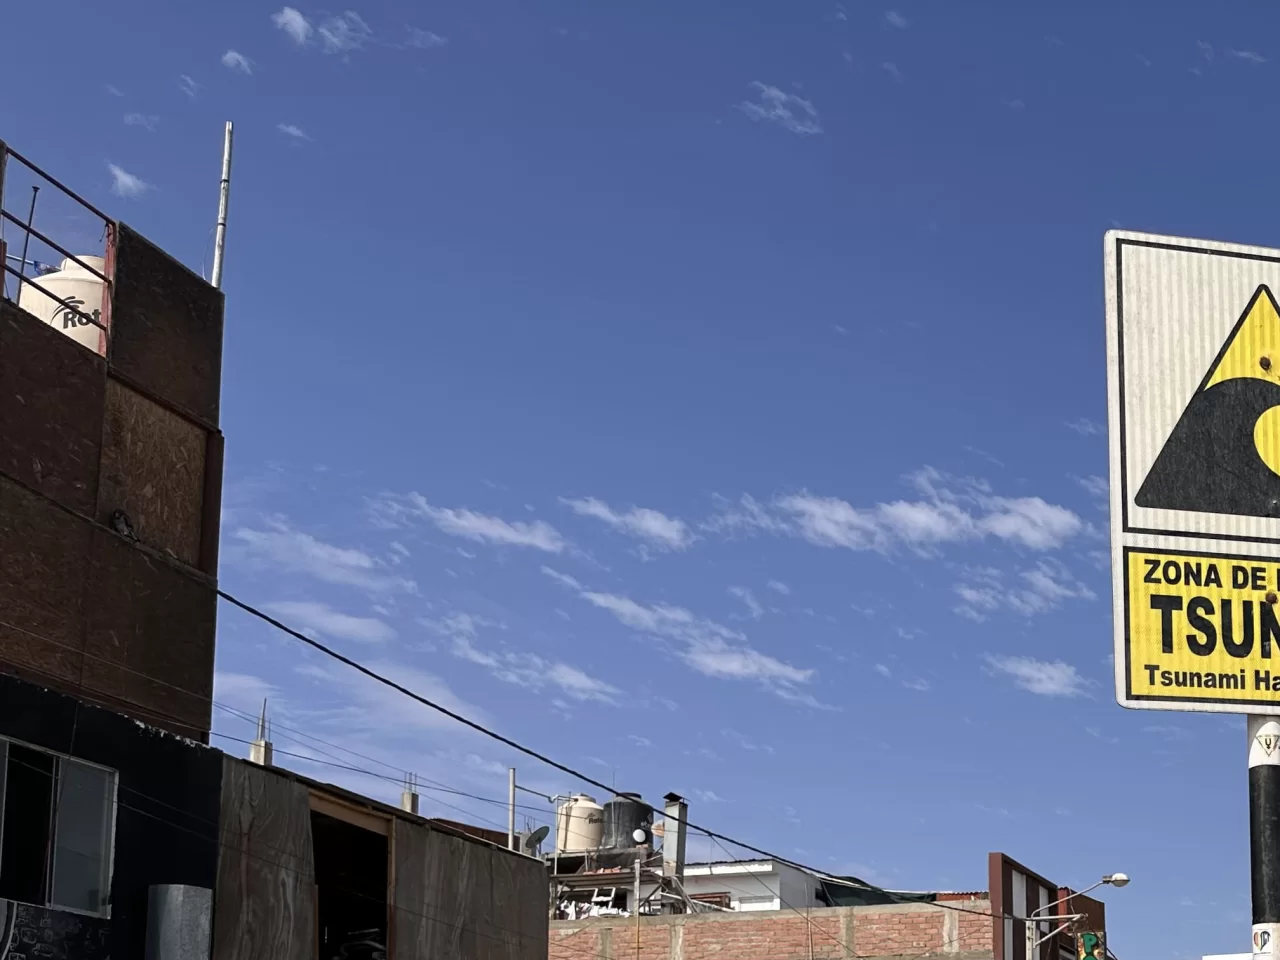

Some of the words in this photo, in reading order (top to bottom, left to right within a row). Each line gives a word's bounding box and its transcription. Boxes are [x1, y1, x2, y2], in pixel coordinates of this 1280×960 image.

[1143, 559, 1222, 588] ZONA
[1232, 566, 1266, 590] DE
[1144, 664, 1245, 690] Tsunami
